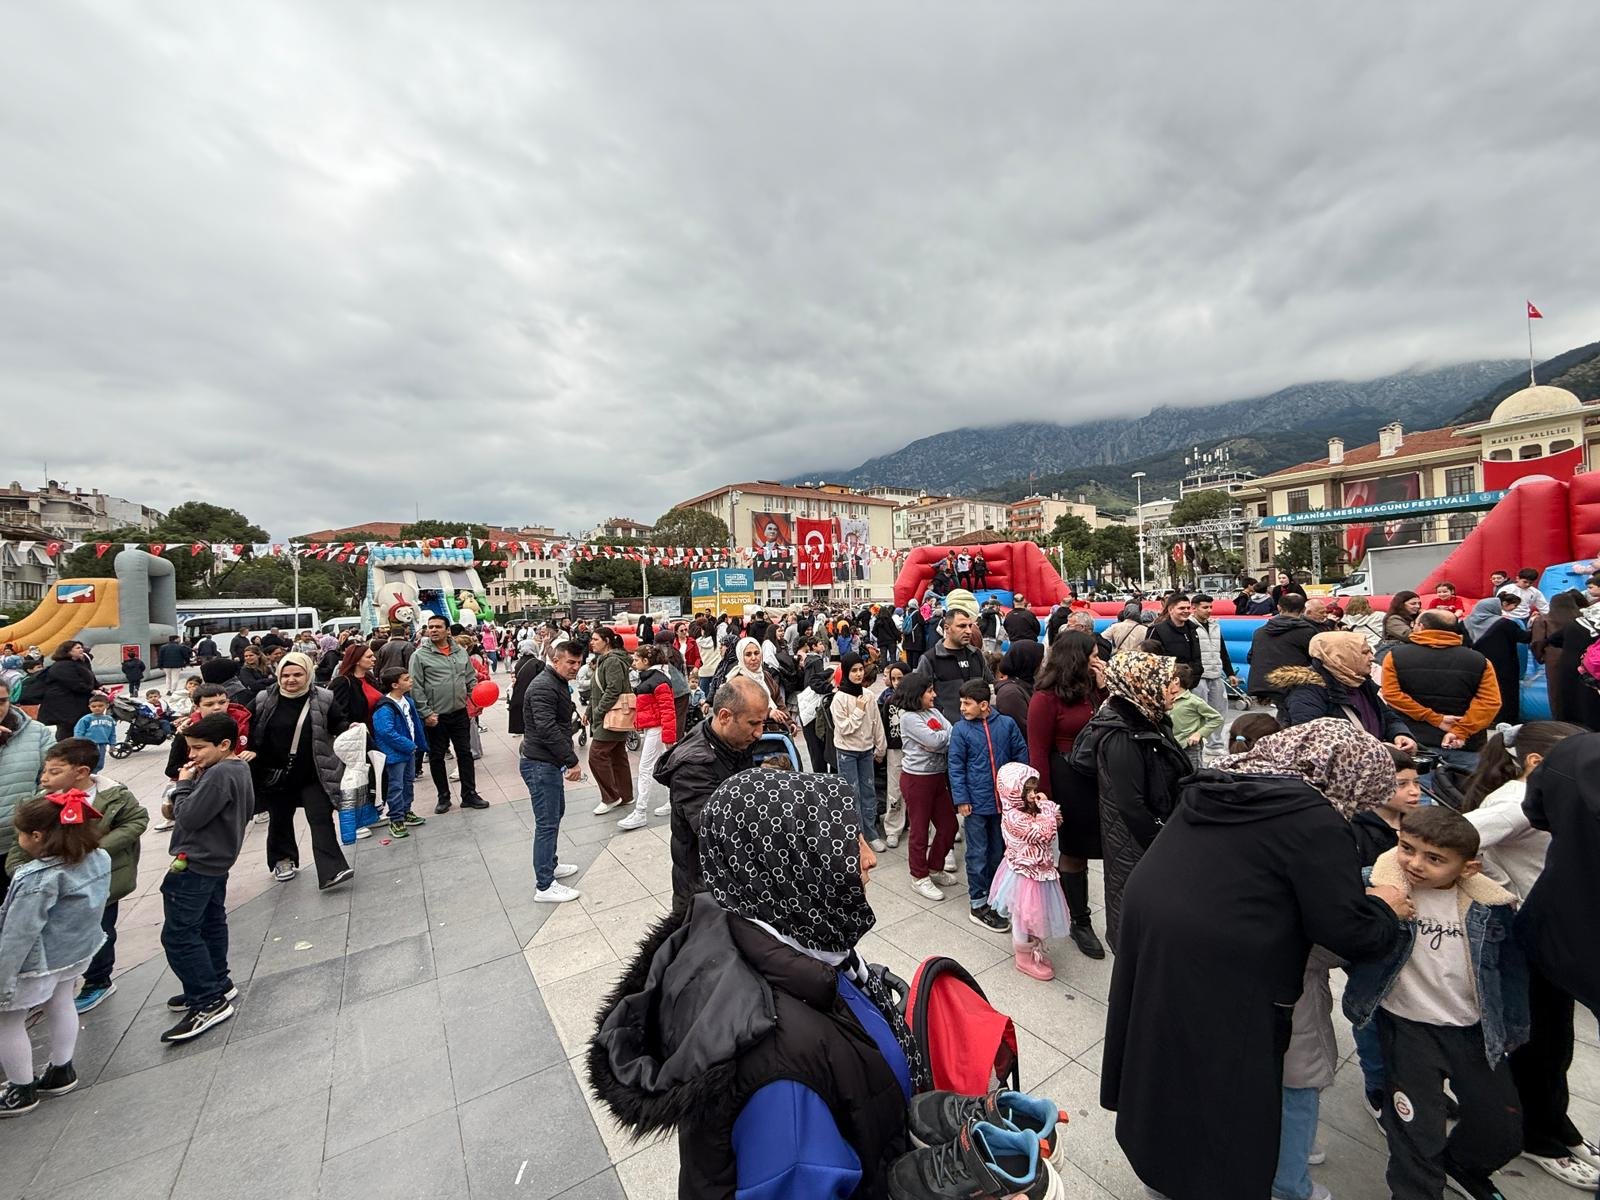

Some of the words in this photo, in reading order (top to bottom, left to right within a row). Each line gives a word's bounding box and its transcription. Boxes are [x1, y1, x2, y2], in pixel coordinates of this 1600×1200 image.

[1296, 511, 1332, 521] MANİSA
[1333, 506, 1363, 517] MESİR
[1364, 502, 1410, 514] MACUNU
[1411, 494, 1470, 508] FESTİVALİ
